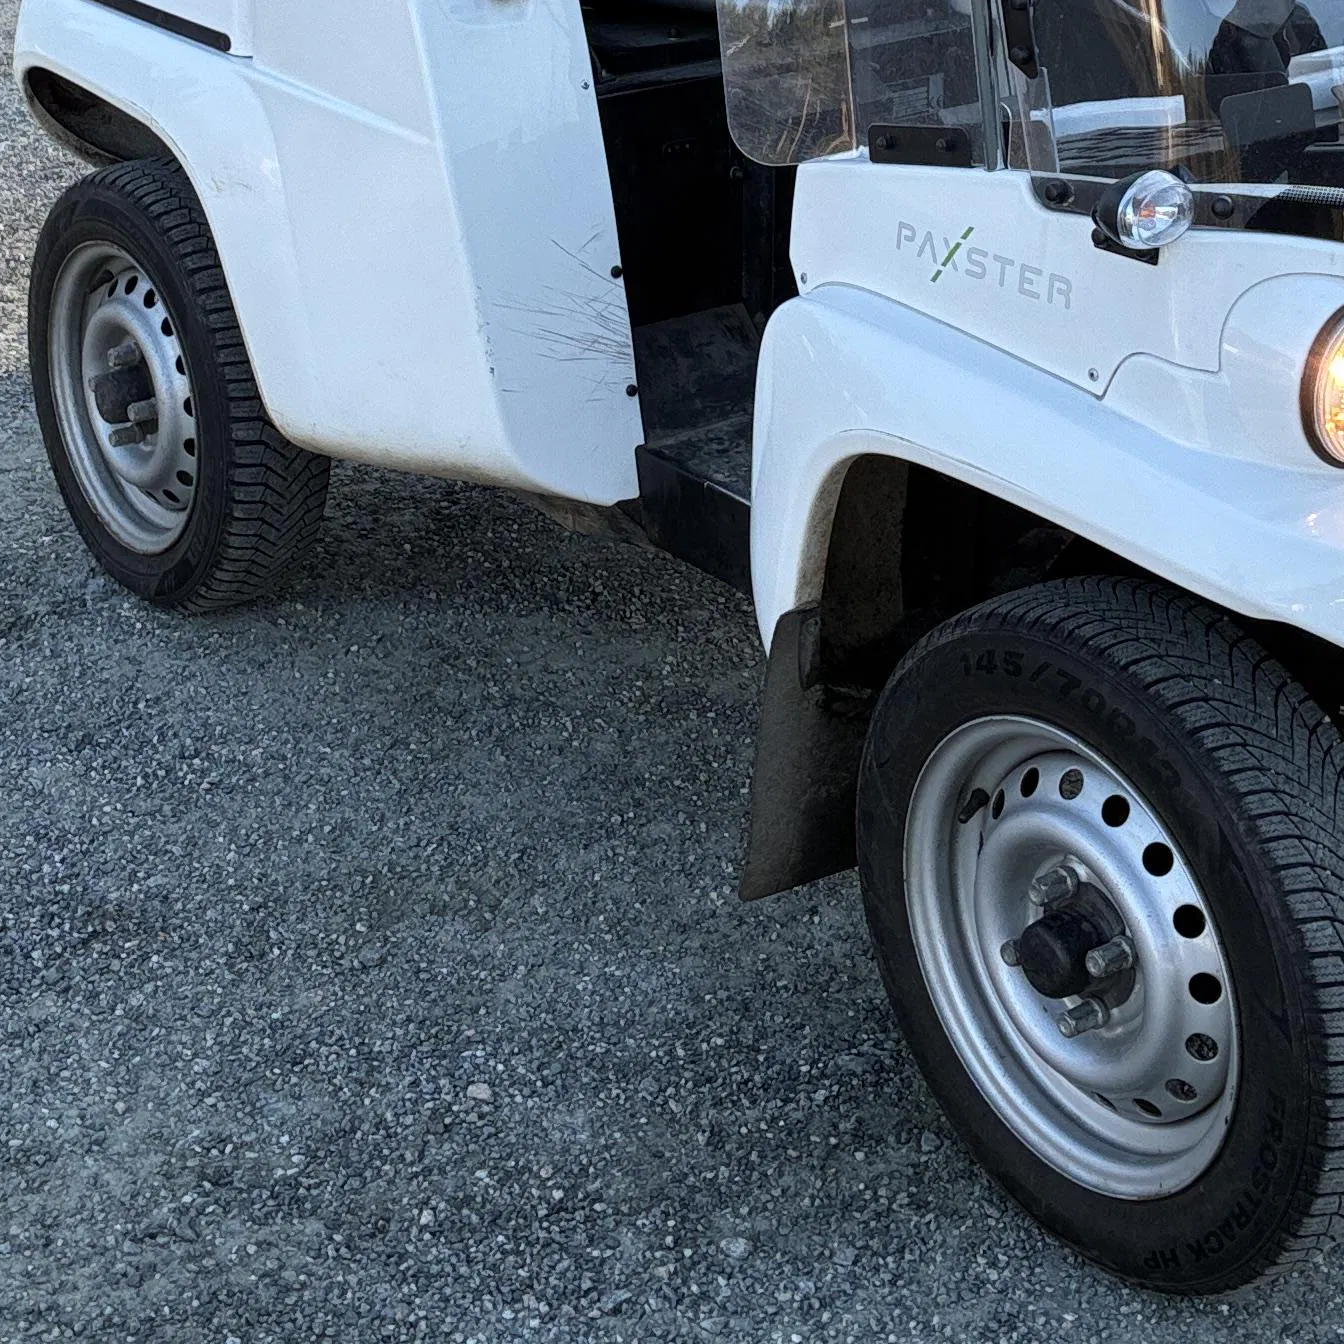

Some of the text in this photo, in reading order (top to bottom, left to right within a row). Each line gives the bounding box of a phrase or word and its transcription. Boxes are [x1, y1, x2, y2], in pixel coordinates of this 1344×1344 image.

[896, 220, 1073, 310] PAXSTER
[1143, 1088, 1285, 1270] FROSTRACK HP
